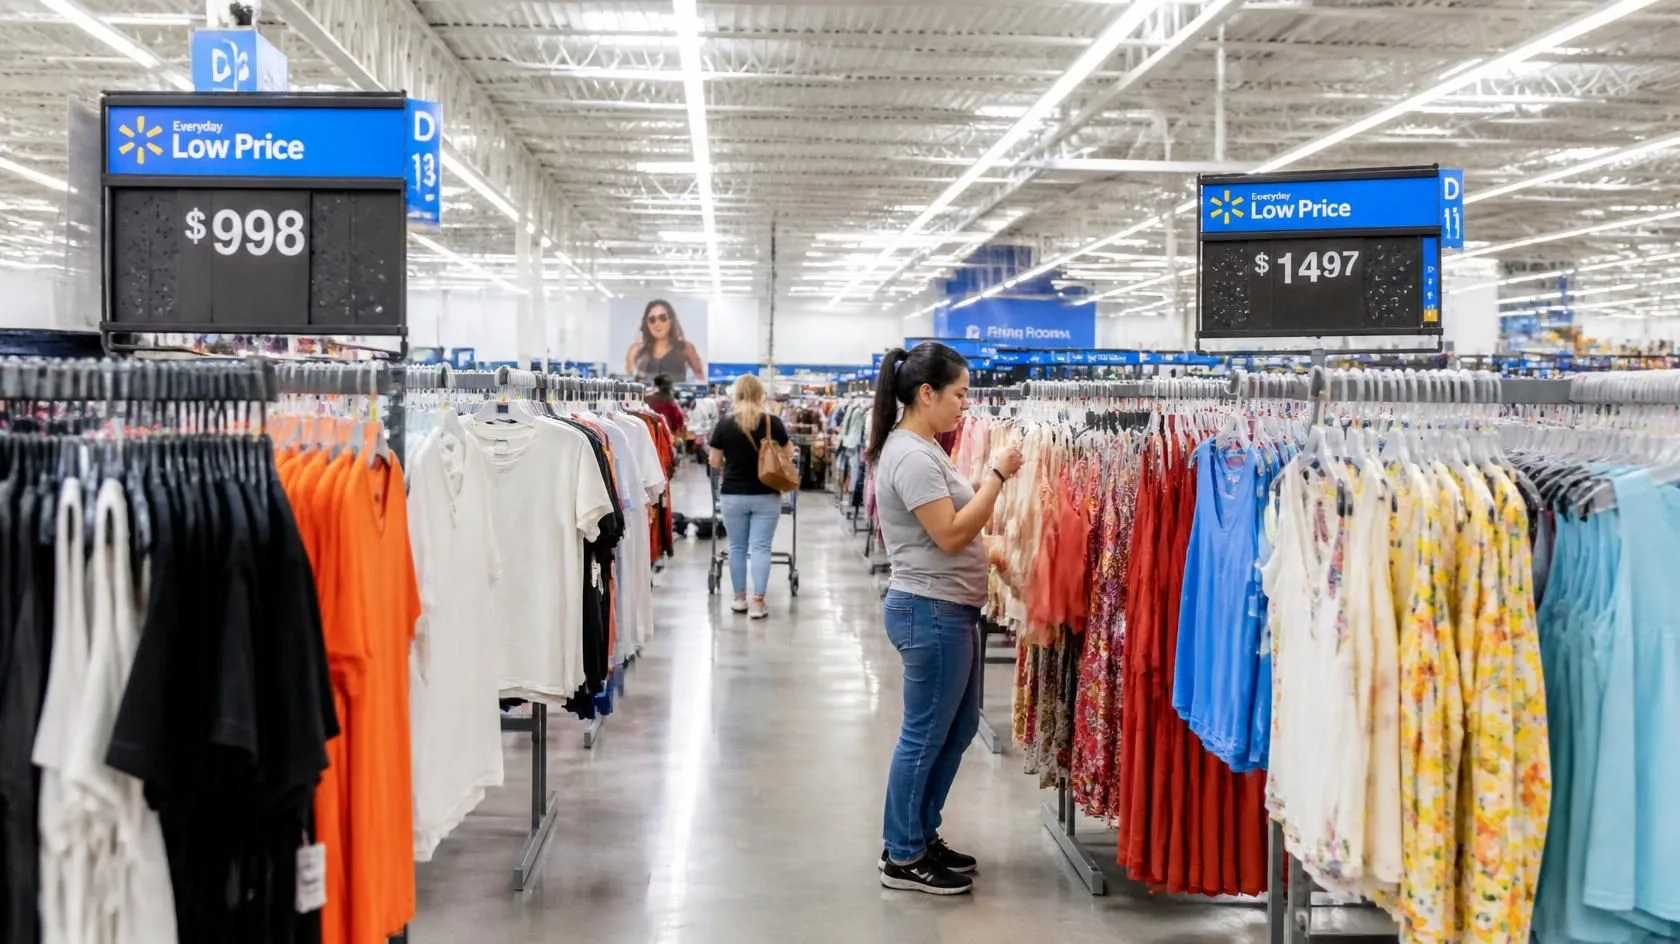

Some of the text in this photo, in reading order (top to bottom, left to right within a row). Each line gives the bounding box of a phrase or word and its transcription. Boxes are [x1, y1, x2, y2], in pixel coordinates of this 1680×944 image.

[172, 120, 223, 134] Everyday
[413, 110, 436, 142] D
[172, 132, 305, 160] Low Price
[1251, 192, 1291, 202] Everyday
[1443, 177, 1460, 201] D
[1251, 198, 1352, 220] Low Price
